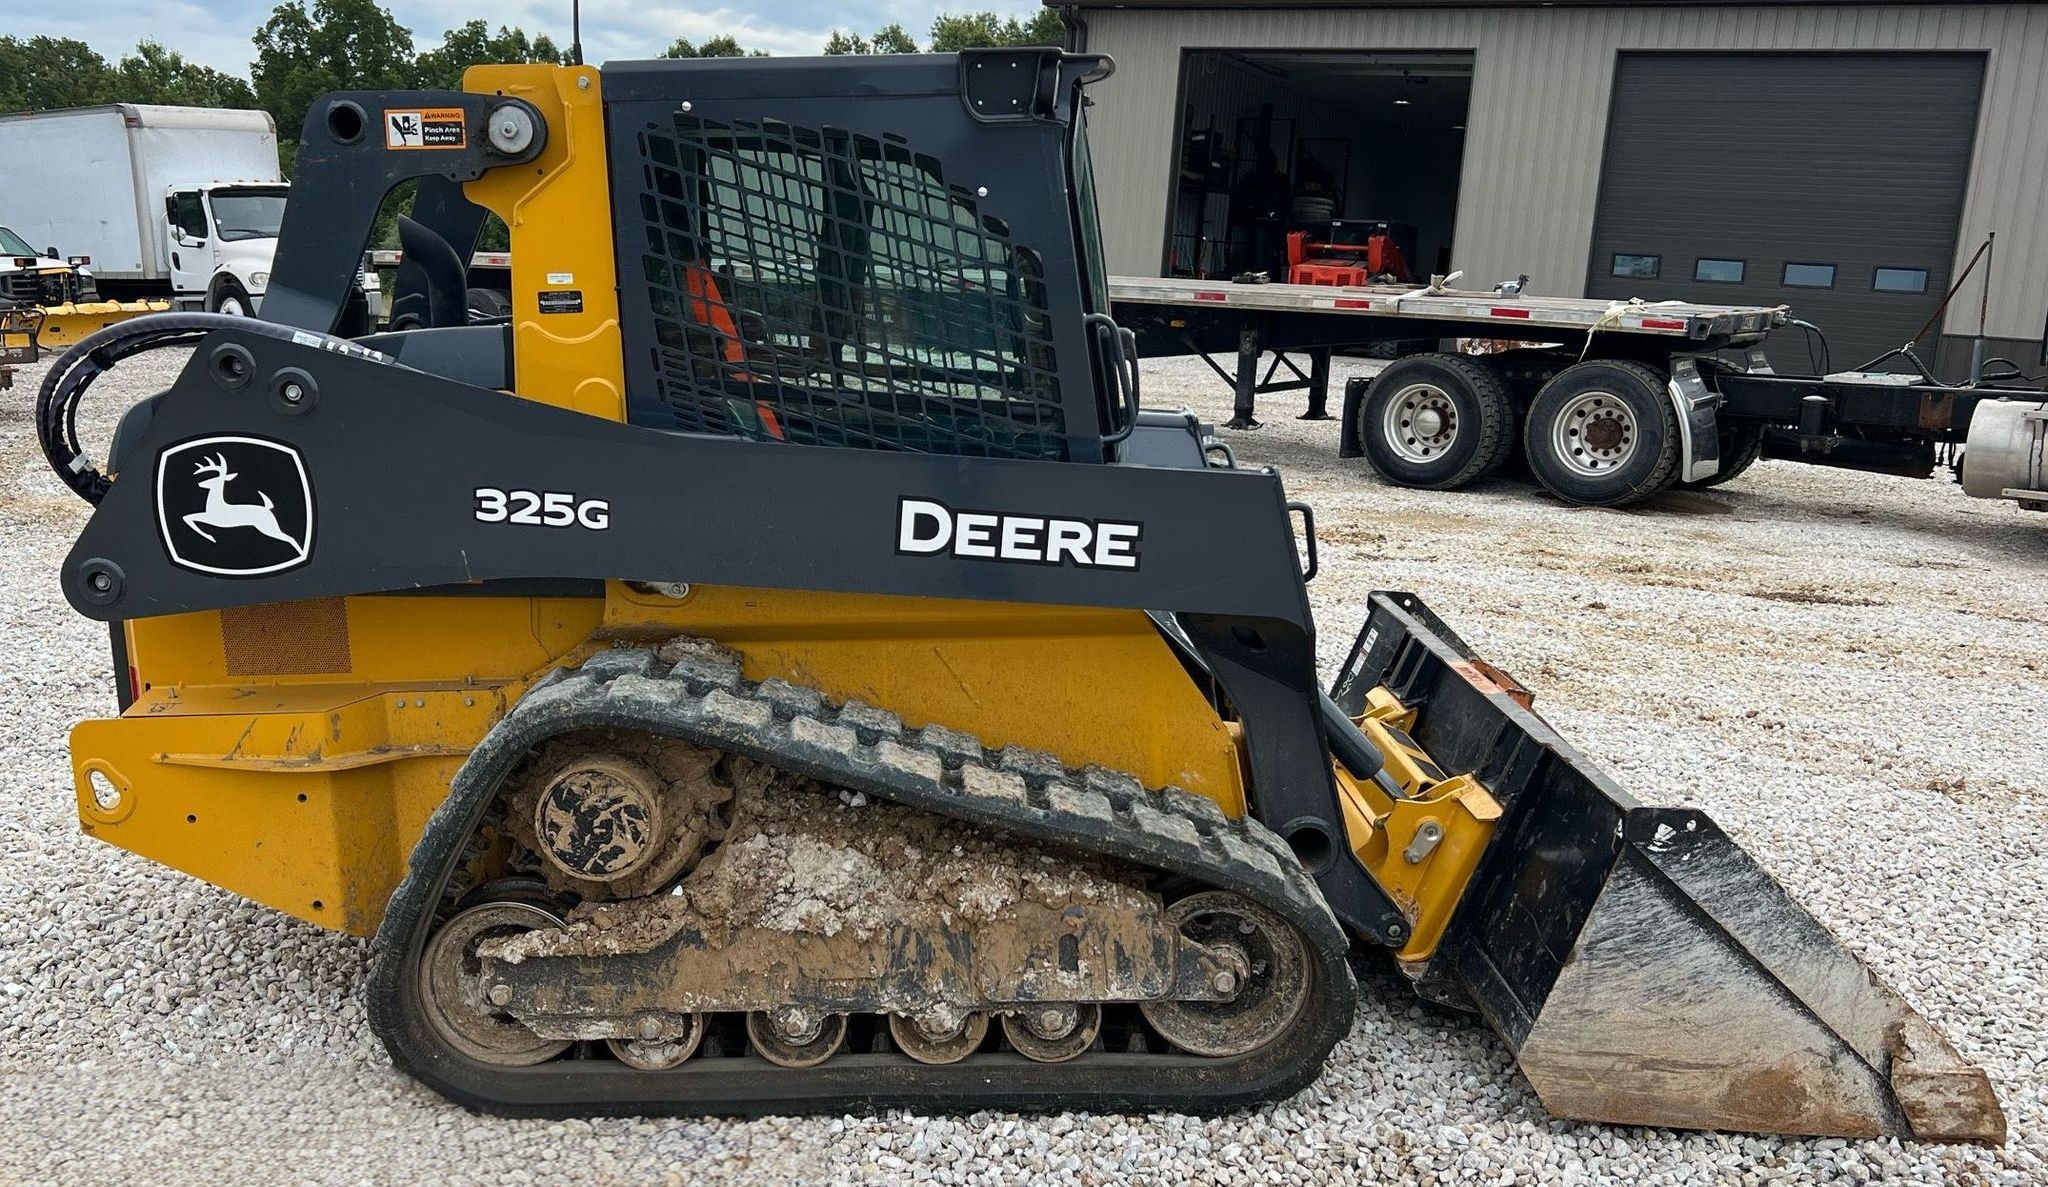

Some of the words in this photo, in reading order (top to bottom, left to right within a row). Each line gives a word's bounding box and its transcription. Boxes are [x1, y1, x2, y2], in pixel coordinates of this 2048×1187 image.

[424, 126, 444, 134] Pinch
[444, 126, 461, 134] Area
[440, 134, 456, 142] Away
[475, 487, 609, 530] 325G
[898, 499, 1140, 567] DEERE
